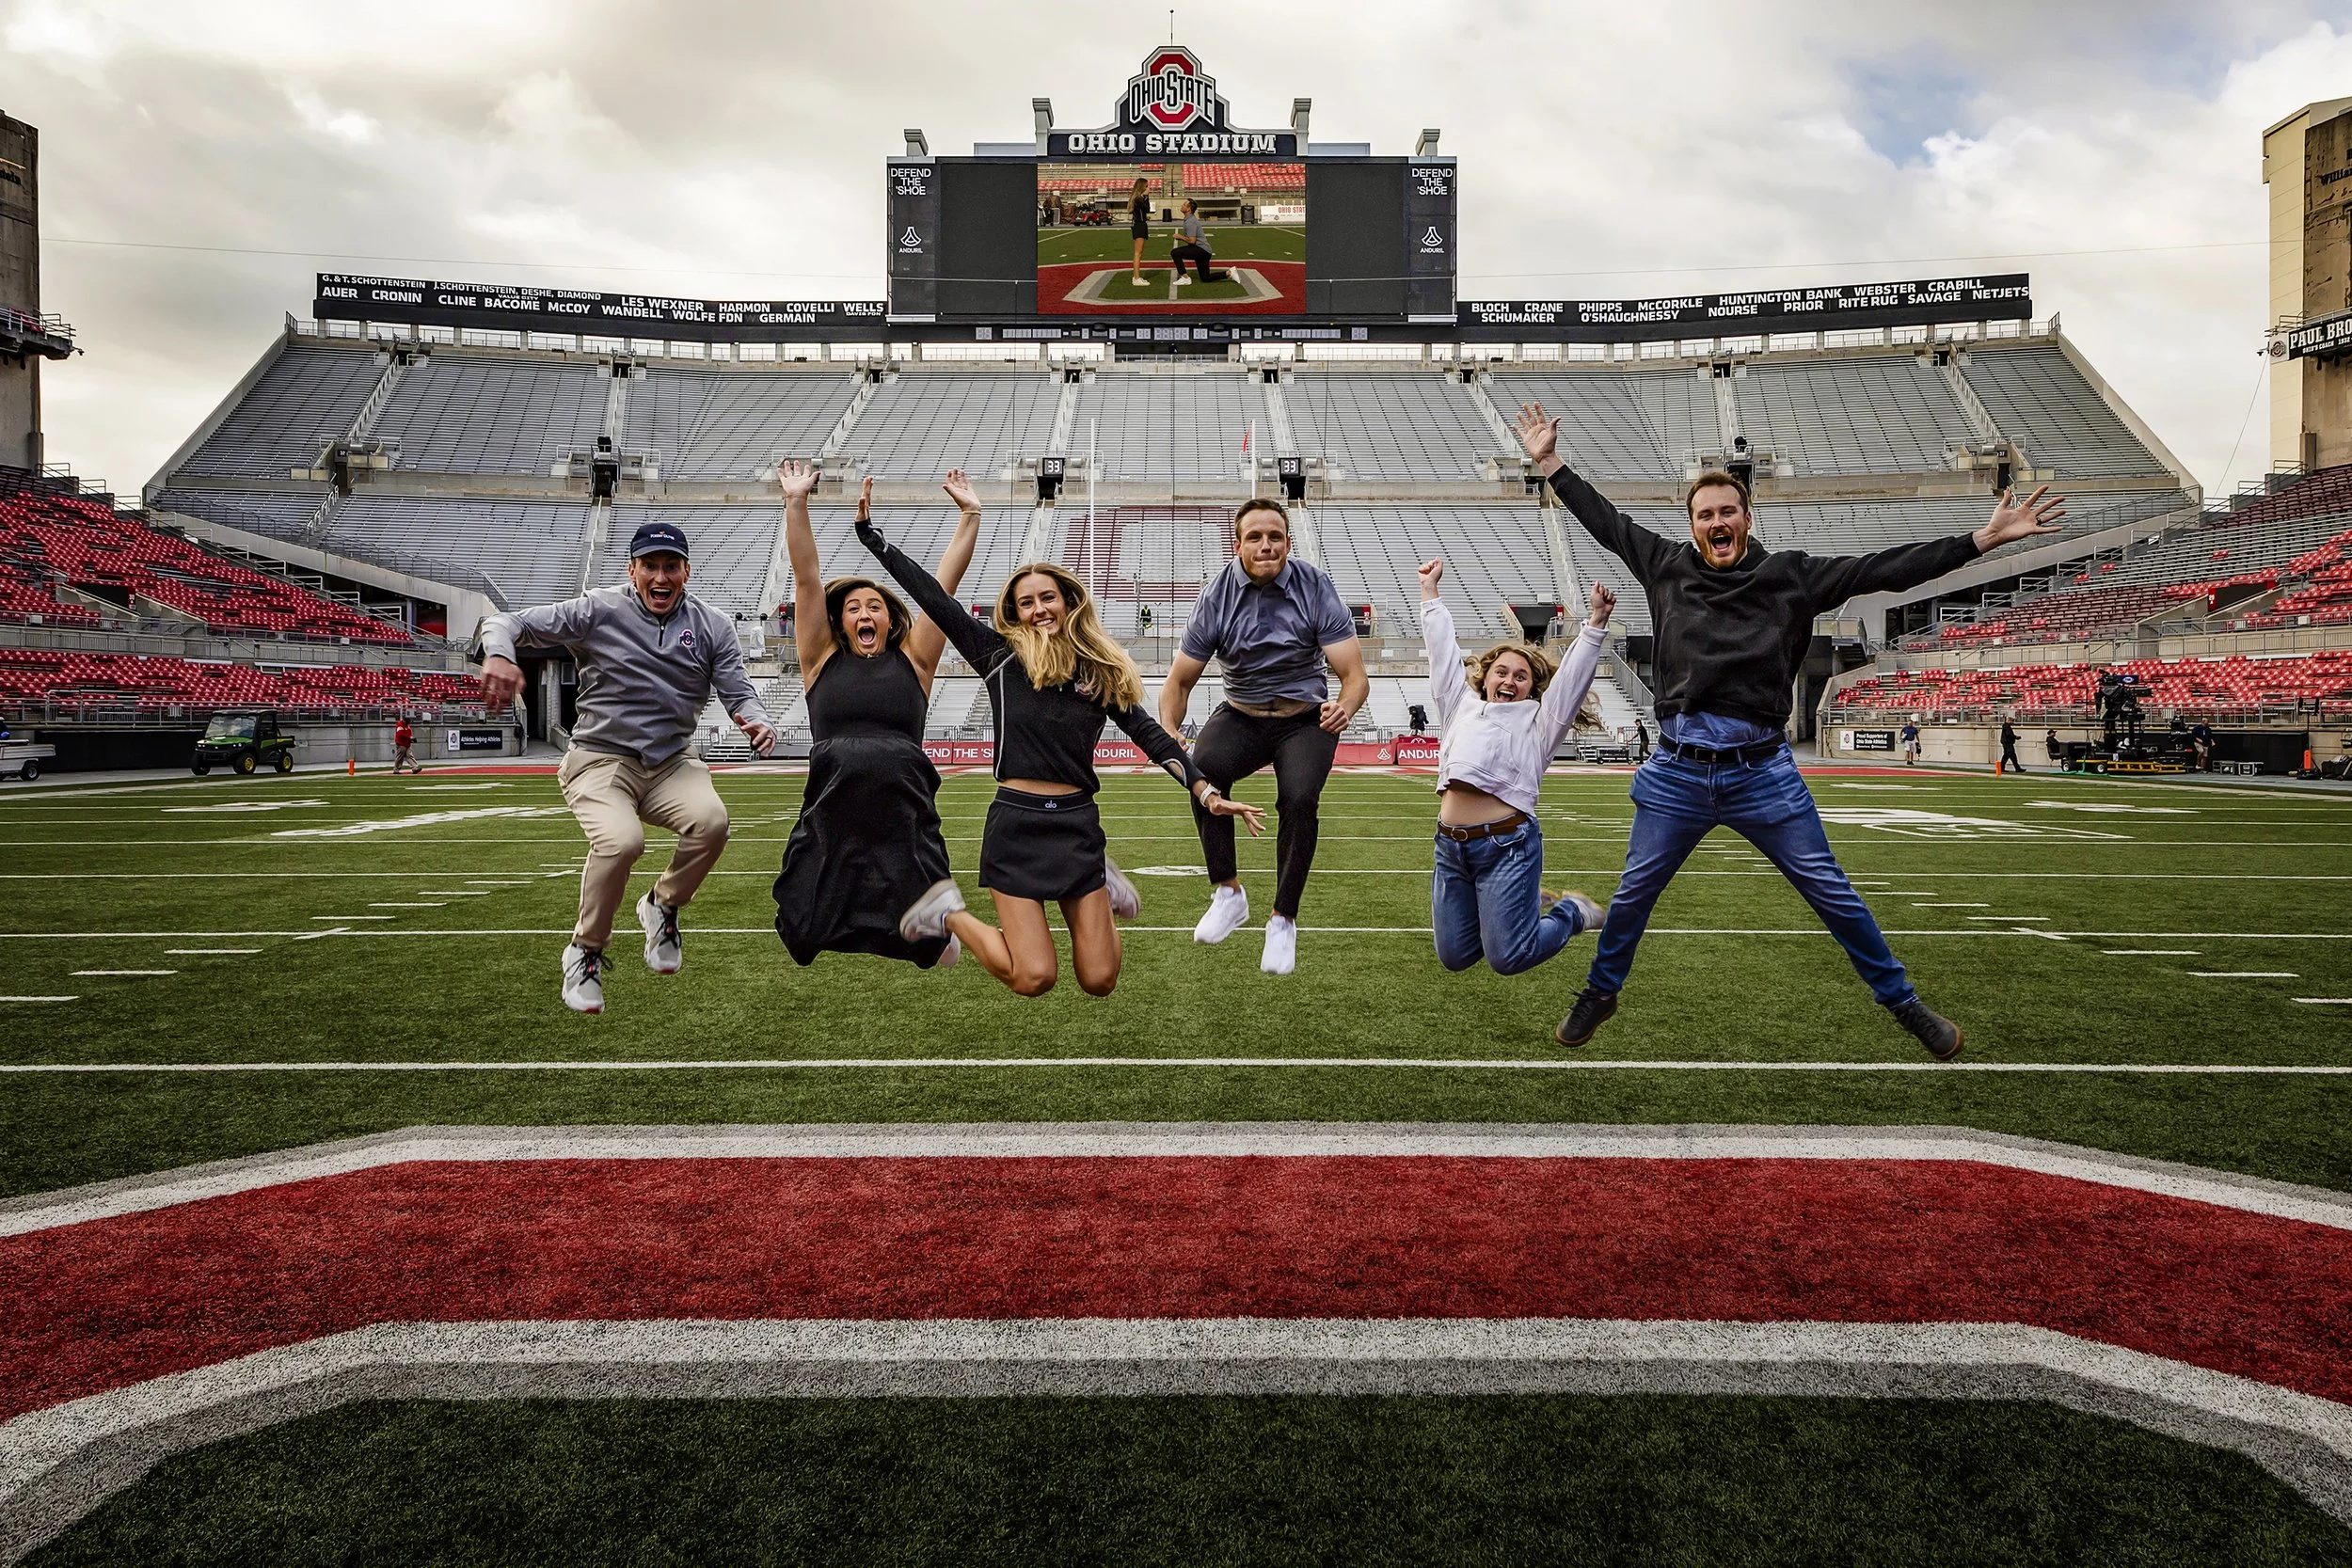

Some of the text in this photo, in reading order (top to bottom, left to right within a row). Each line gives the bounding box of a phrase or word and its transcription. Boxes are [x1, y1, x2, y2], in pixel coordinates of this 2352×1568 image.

[1131, 71, 1213, 122] OHIO STATE
[1068, 134, 1277, 154] OHIO STADIUM
[890, 167, 931, 178] DEFEND
[1411, 167, 1454, 178] DEFEND
[900, 177, 922, 186] THE
[1422, 177, 1443, 186] THE
[896, 185, 927, 196] 'SHOE
[1417, 185, 1448, 196] 'SHOE
[351, 277, 426, 289] SCHOTTENSTEIN
[1853, 282, 1916, 296] WEBSTER
[1927, 278, 1985, 293] CRABILL
[322, 287, 358, 299] AUER
[372, 290, 422, 303] CRONIN
[557, 290, 601, 301] DIAMOND
[1719, 288, 1843, 307] HUNTINGTON BANK
[1907, 291, 1962, 304] SAVAGE
[1972, 286, 2029, 300] NETJETS
[437, 294, 477, 307] CLINE
[484, 297, 541, 311] BACOME
[621, 296, 705, 311] LES WEXNER
[1783, 300, 1824, 313] PRIOR
[601, 305, 664, 319] WANDELL
[719, 302, 771, 313] HARMON
[786, 302, 834, 313] COVELLI
[842, 302, 884, 313] WELLS
[1471, 302, 1510, 313] BLOCH
[1524, 302, 1564, 313] CRANE
[1578, 302, 1623, 313] PHIPPS
[1708, 304, 1758, 318] NOURSE
[673, 309, 743, 324] WOLFE FDN
[759, 312, 816, 324] GERMAIN
[1481, 312, 1555, 324] SCHUMAKER
[1581, 309, 1680, 324] O'SHAUGHNESSY
[2290, 326, 2325, 350] PAUL
[1048, 460, 1060, 472] 33
[1283, 460, 1296, 472] 33
[922, 748, 950, 758] END
[953, 748, 978, 758] THE
[1094, 748, 1137, 758] NDURIL
[1399, 749, 1440, 759] ANDUR
[1044, 800, 1057, 809] alo
